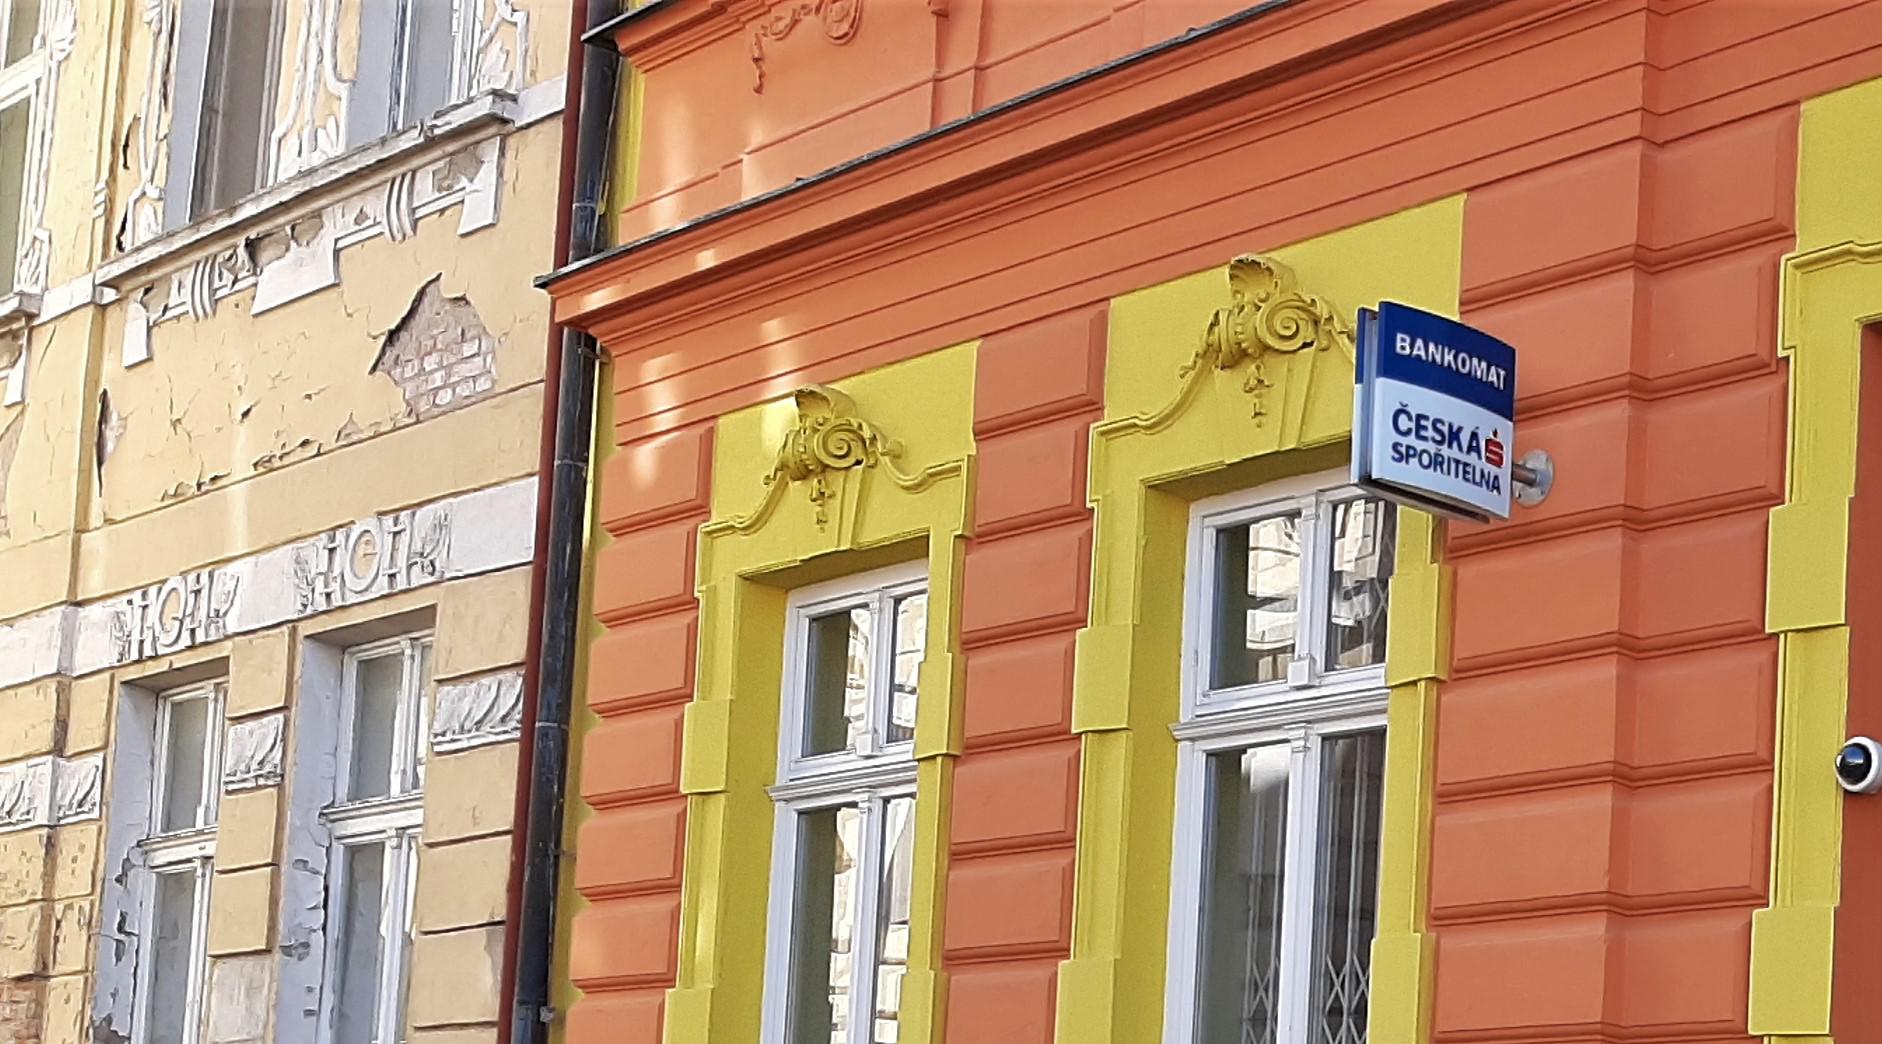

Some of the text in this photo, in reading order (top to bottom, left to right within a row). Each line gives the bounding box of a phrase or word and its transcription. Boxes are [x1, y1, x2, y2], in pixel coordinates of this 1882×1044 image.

[1395, 333, 1506, 391] BANKOMAT
[1392, 402, 1482, 461] ČESKÁ
[1391, 442, 1502, 495] SPOŘITELNA
